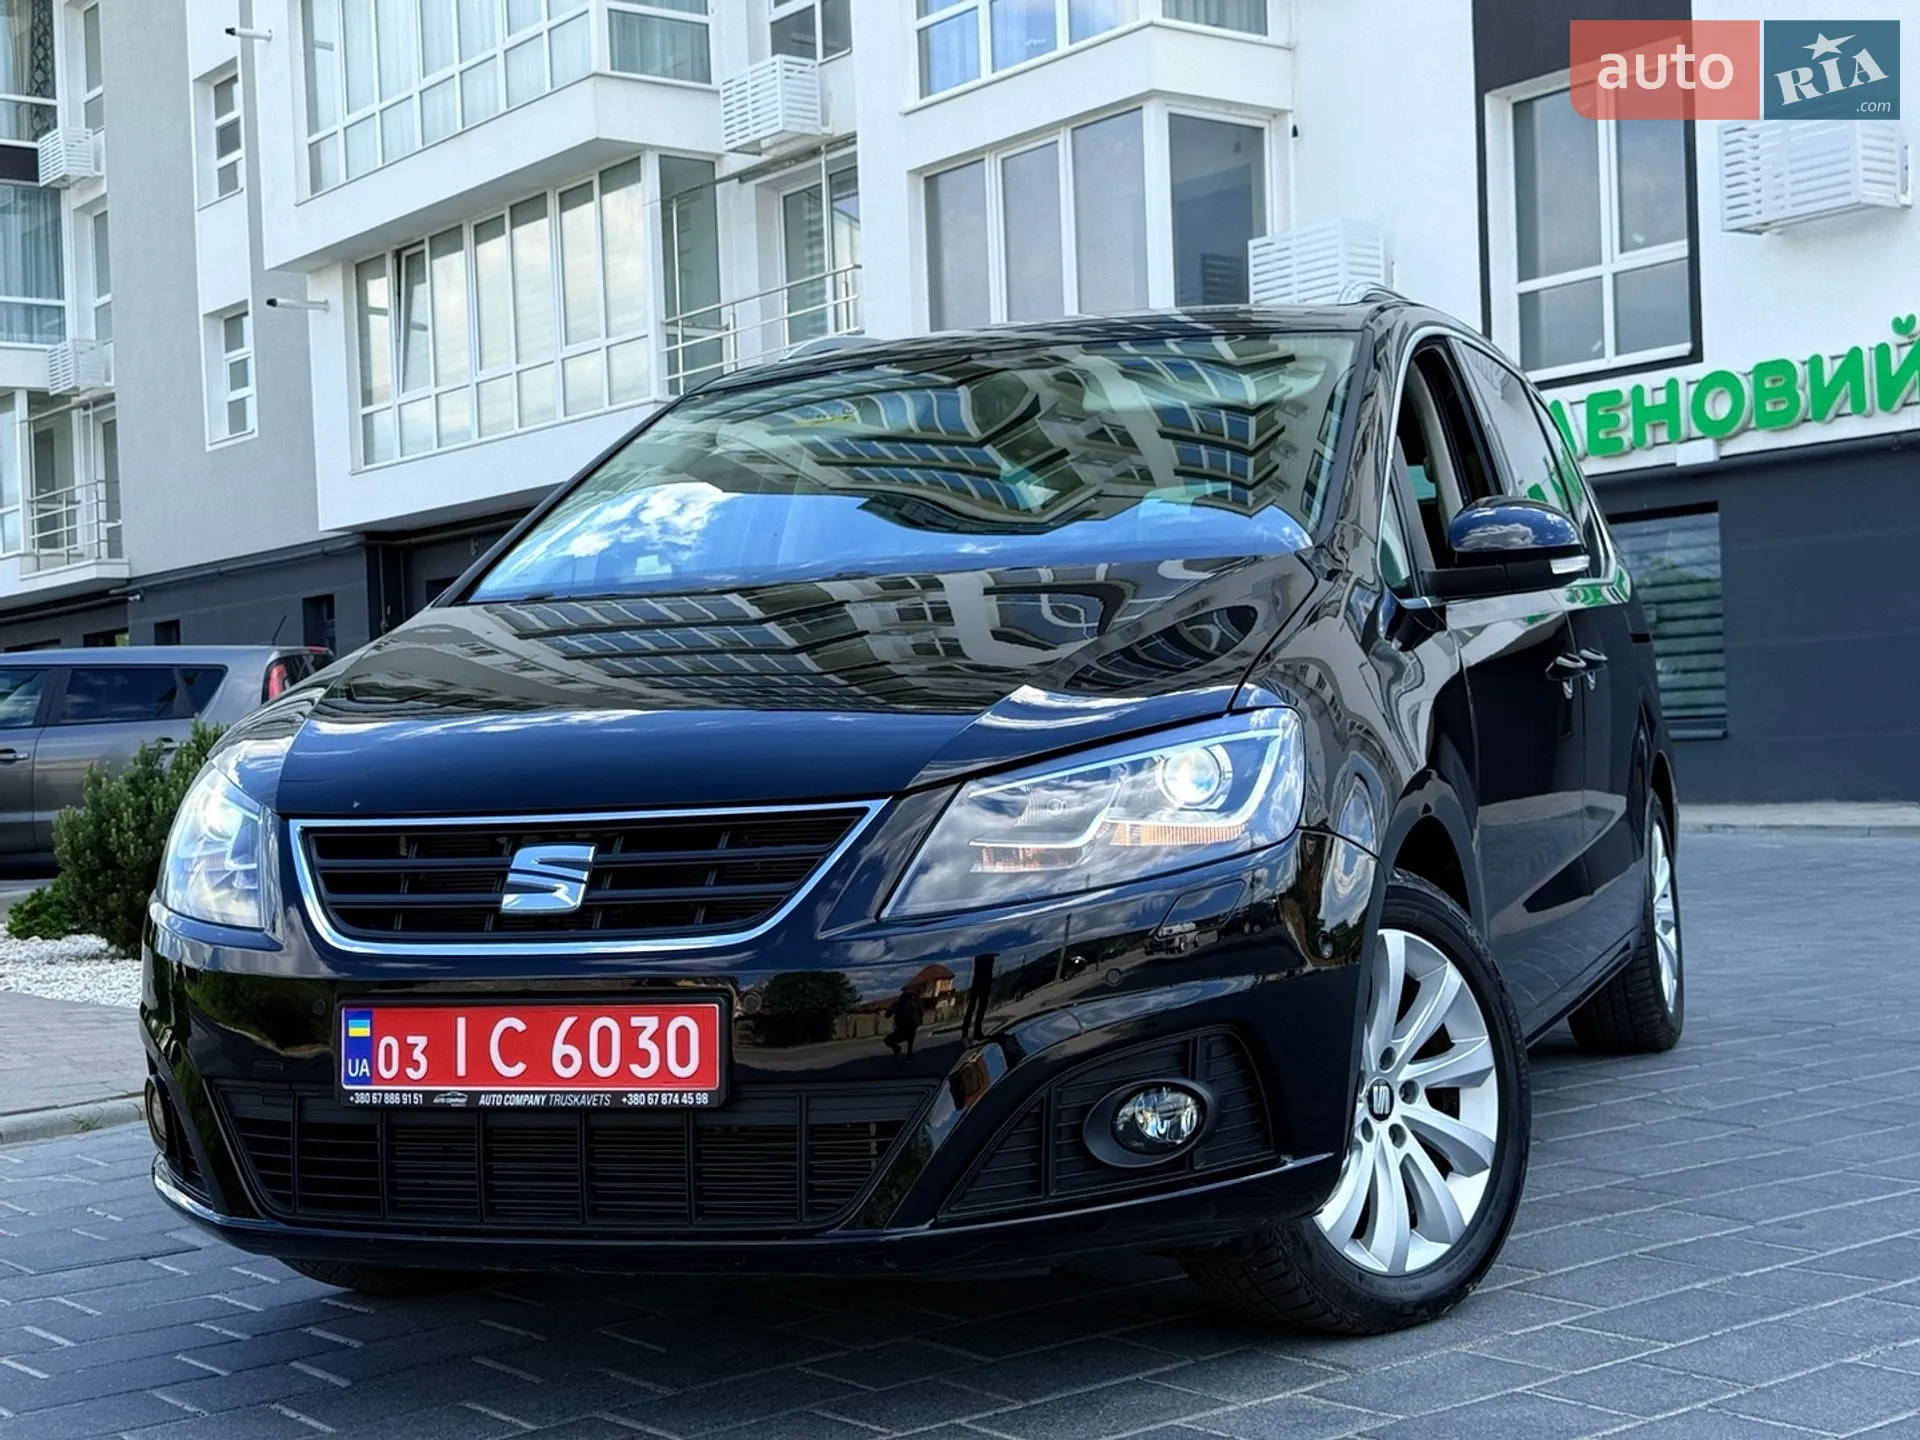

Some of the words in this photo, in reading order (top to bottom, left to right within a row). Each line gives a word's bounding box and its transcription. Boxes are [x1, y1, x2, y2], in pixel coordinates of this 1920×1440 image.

[347, 1058, 371, 1077] UA
[377, 1035, 428, 1080] 03
[551, 1015, 700, 1079] 6030
[478, 1093, 502, 1106] AUTO
[503, 1093, 548, 1106] COMPANY
[548, 1093, 612, 1107] TRUSKAVETS
[621, 1093, 646, 1106] +380
[646, 1093, 659, 1106] 67
[661, 1093, 680, 1106] 874
